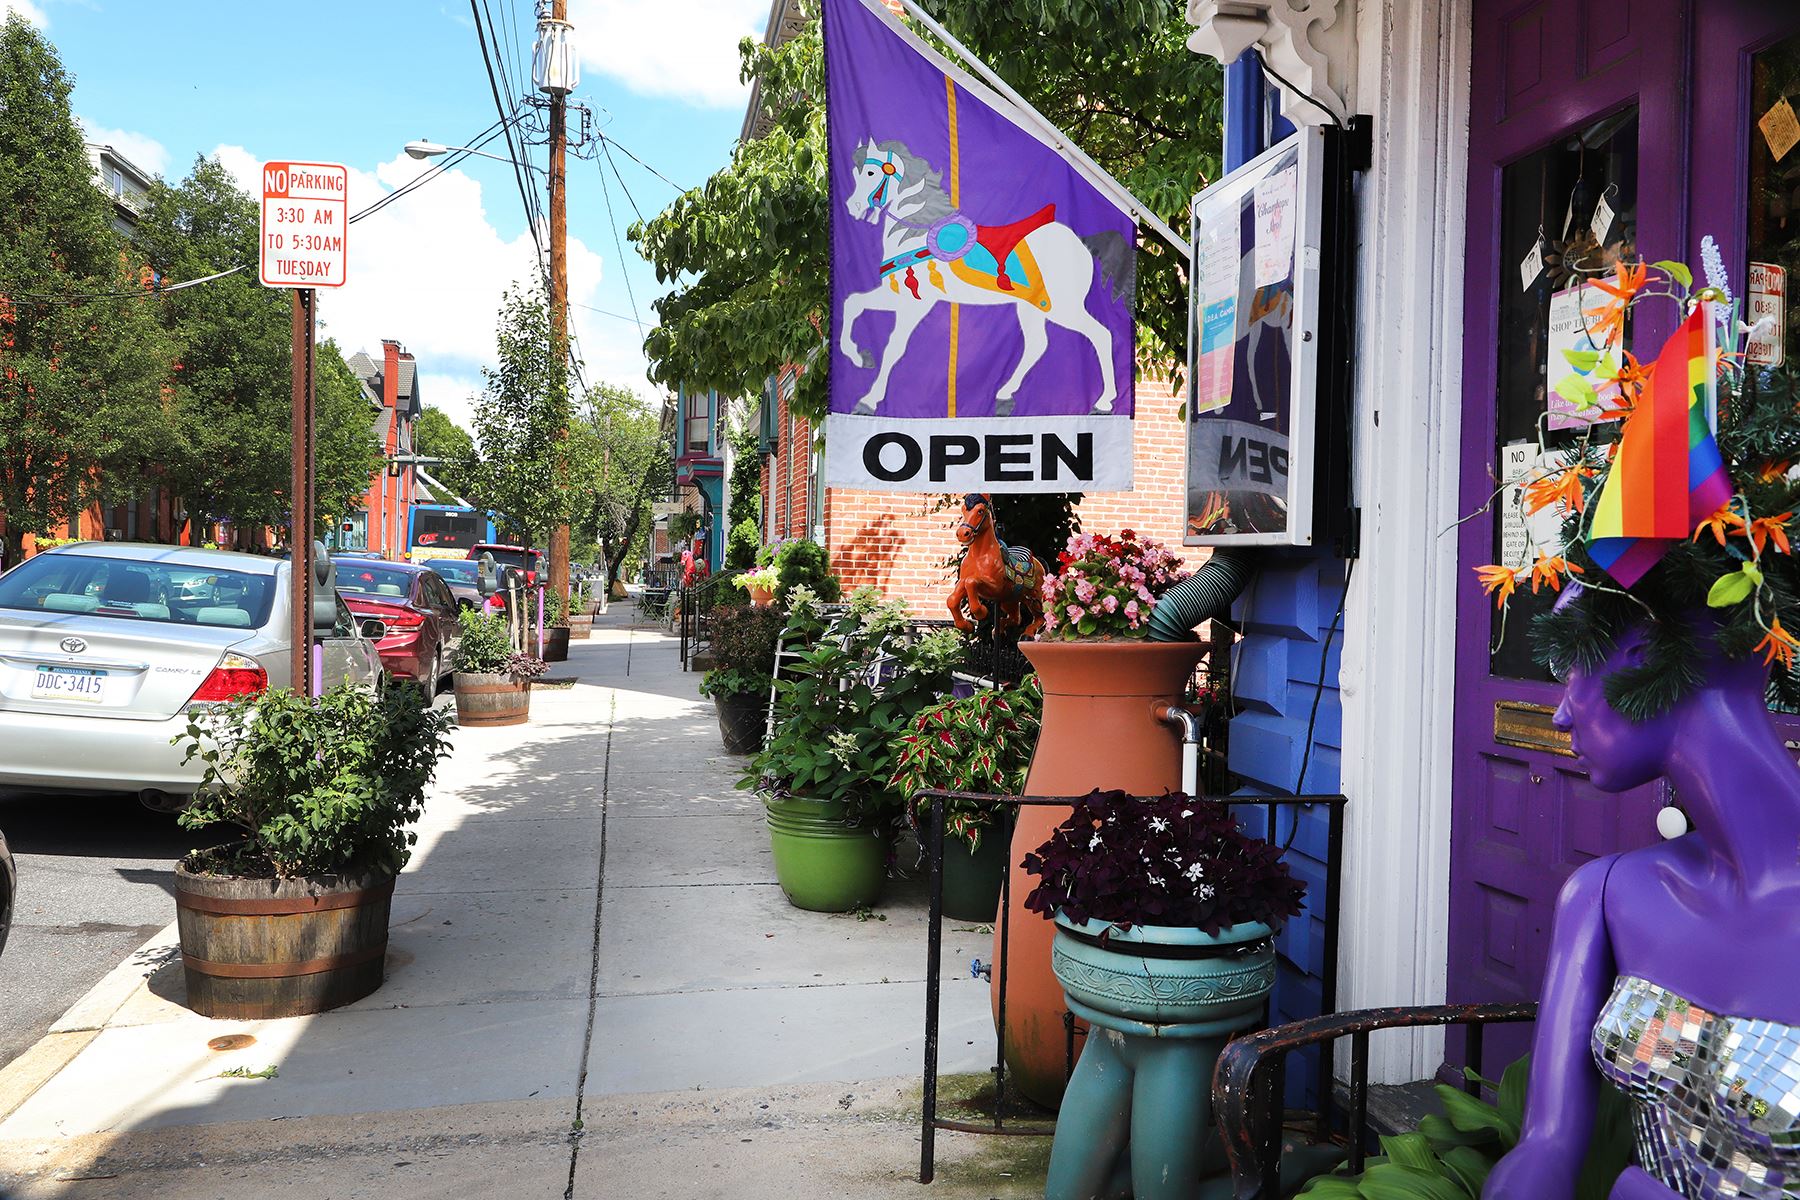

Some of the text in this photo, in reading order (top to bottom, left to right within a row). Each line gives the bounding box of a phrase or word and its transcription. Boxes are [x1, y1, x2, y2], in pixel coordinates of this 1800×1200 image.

[265, 170, 343, 193] NO PARKING
[277, 207, 333, 224] 3:30 AM
[268, 234, 341, 251] TO 5:30AM
[277, 260, 331, 276] TUESDAY
[1551, 320, 1572, 332] SHOP
[1551, 400, 1566, 408] Like
[862, 431, 1093, 482] OPEN
[1511, 450, 1525, 463] NO
[155, 666, 189, 674] CAMRY
